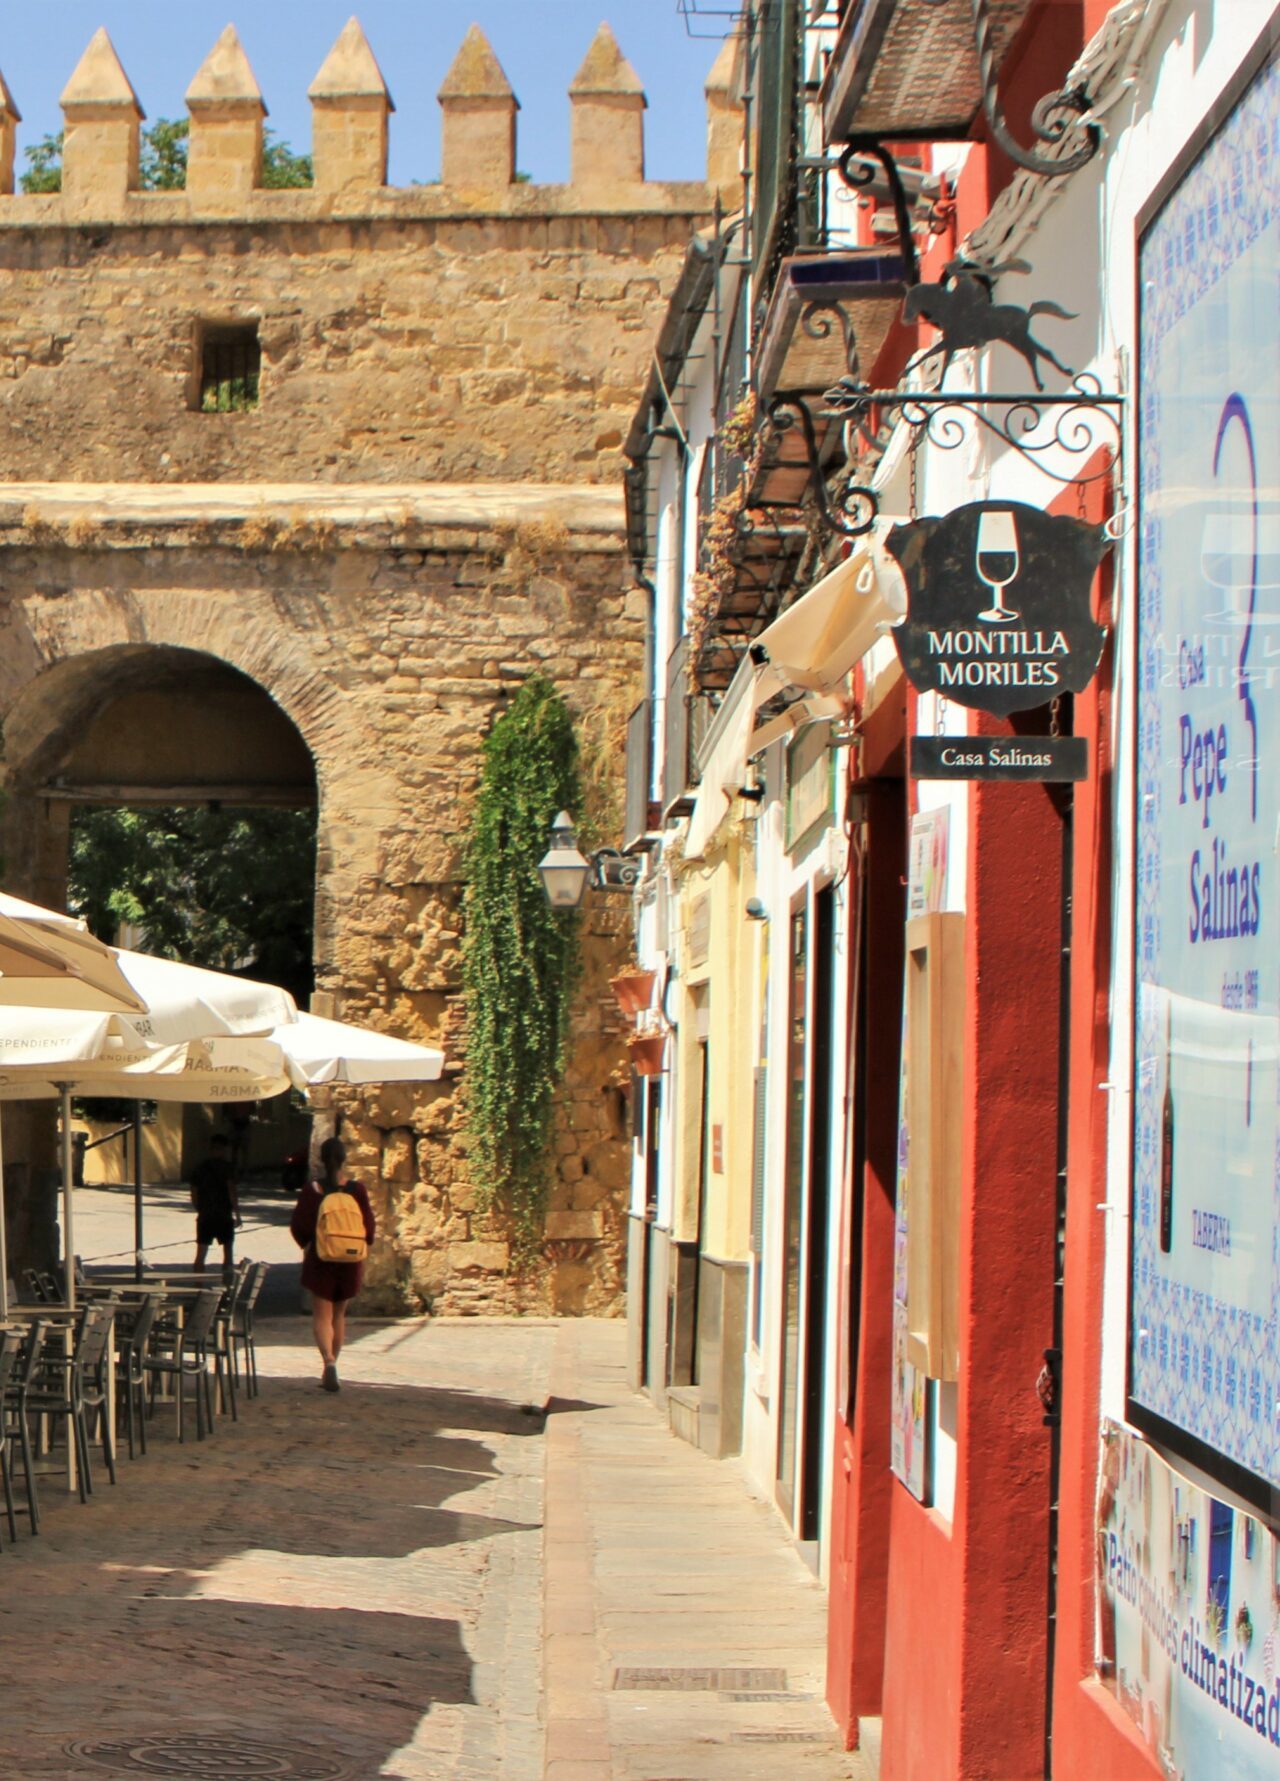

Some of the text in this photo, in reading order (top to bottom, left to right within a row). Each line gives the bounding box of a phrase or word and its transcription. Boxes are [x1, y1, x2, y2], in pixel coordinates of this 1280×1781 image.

[927, 631, 1069, 655] MONTILLA
[939, 661, 1059, 686] MORILES
[941, 748, 1052, 766] Casa Salinas
[1179, 714, 1227, 829] Pepe
[1189, 836, 1260, 944] Salinas
[1192, 1208, 1231, 1257] TABERNA
[1108, 1532, 1137, 1607] Patio
